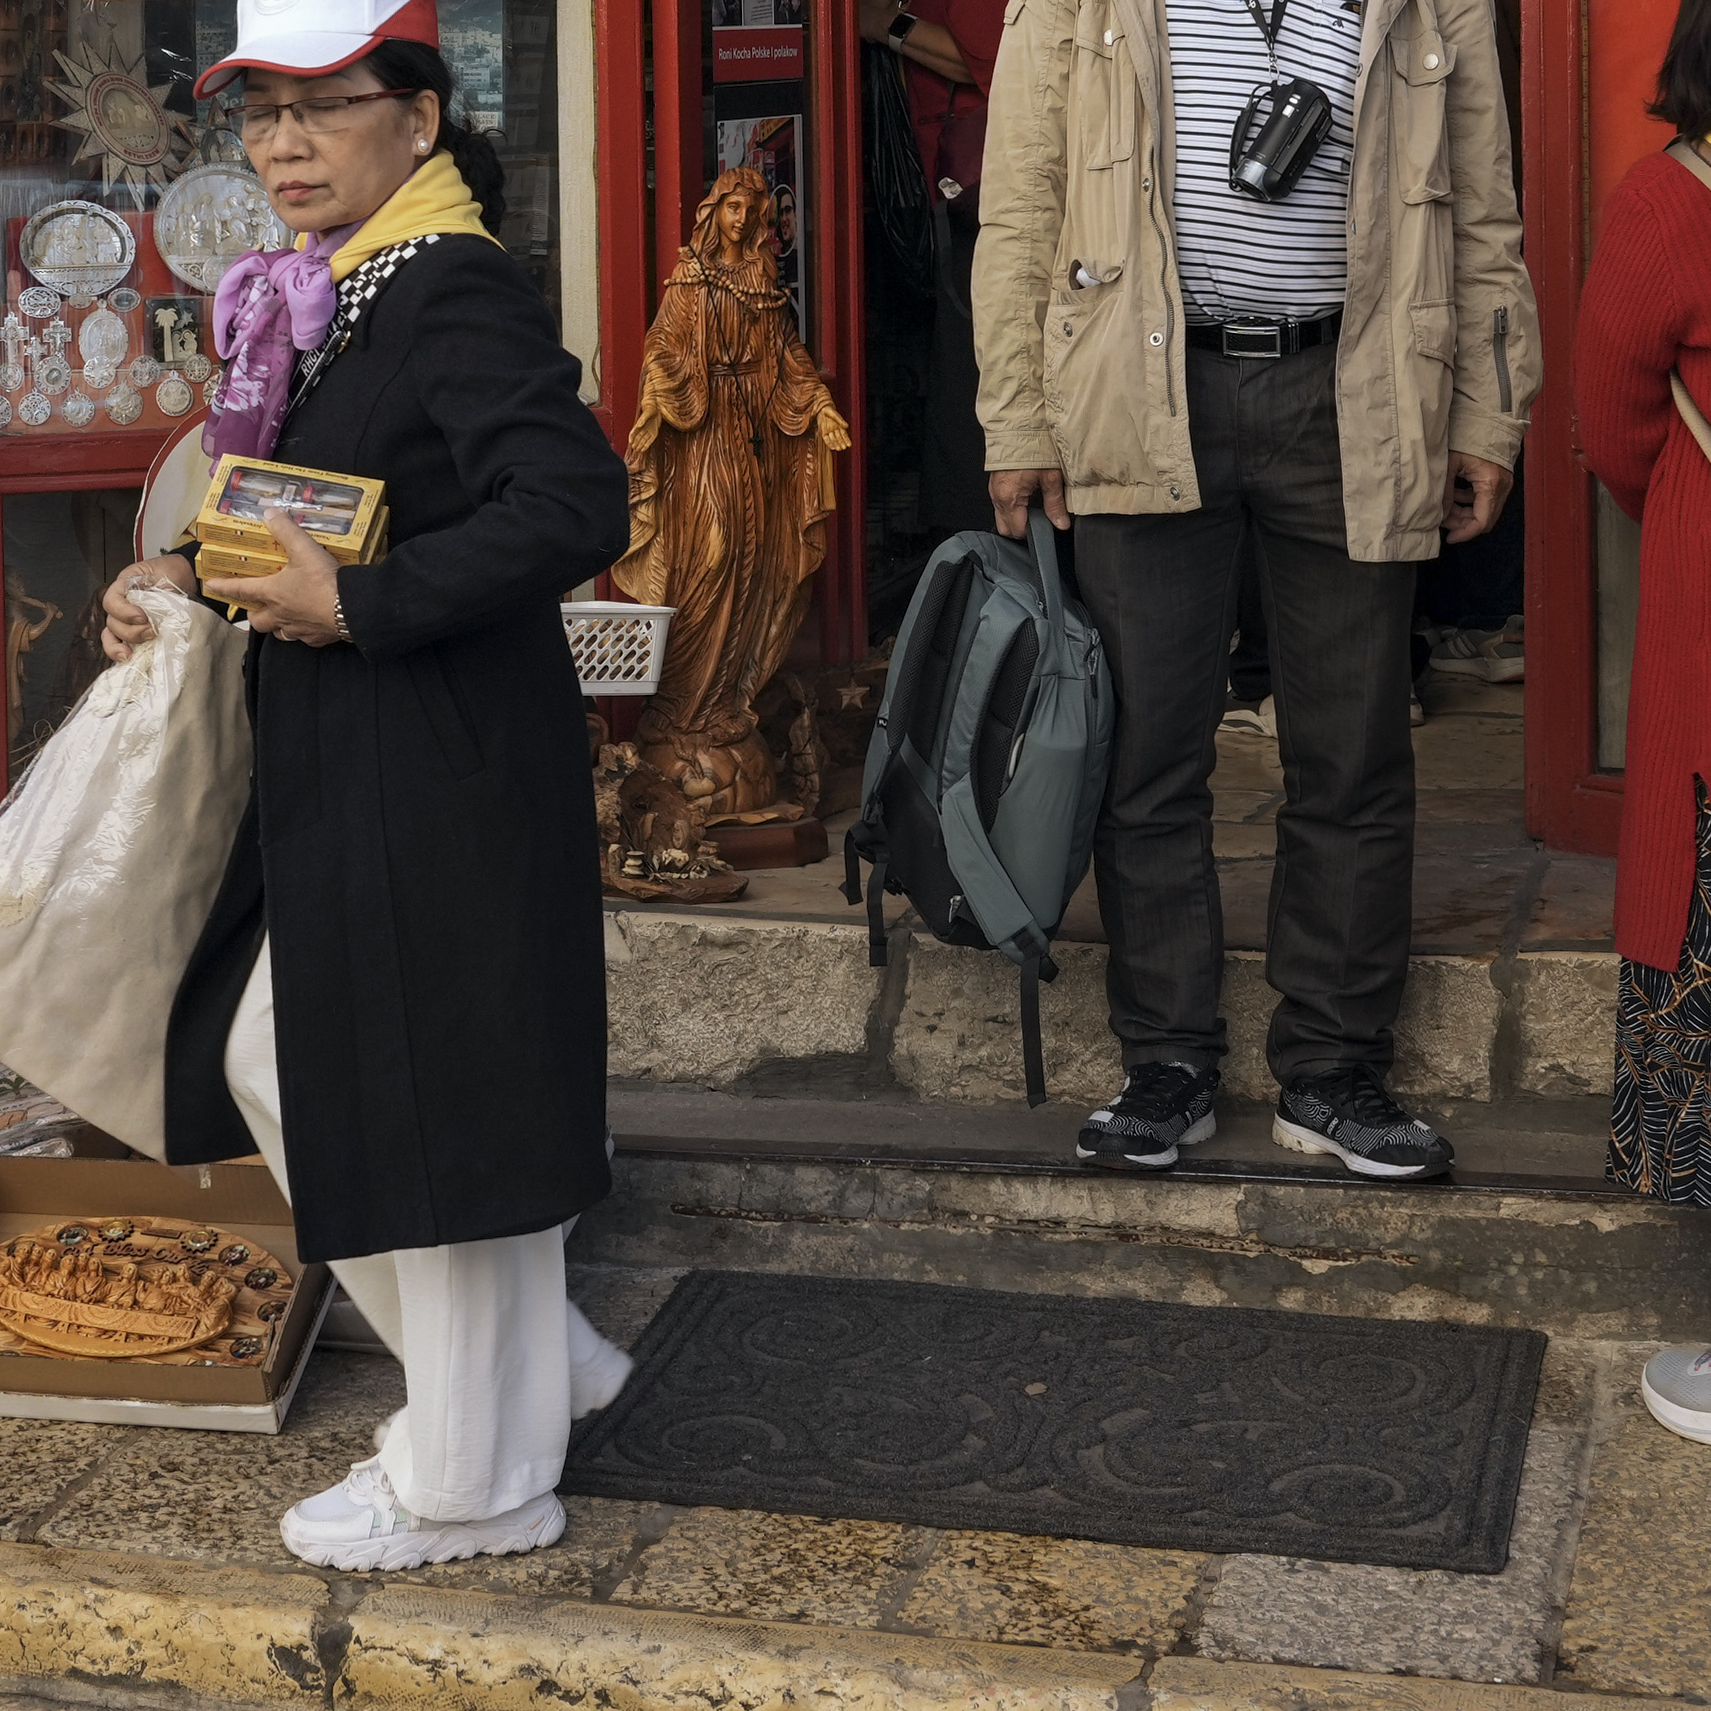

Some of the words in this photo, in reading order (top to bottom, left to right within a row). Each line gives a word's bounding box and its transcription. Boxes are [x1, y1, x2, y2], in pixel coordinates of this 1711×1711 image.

[718, 46, 732, 61] Roni
[733, 47, 751, 61] Kocha
[103, 1243, 149, 1257] Bless
